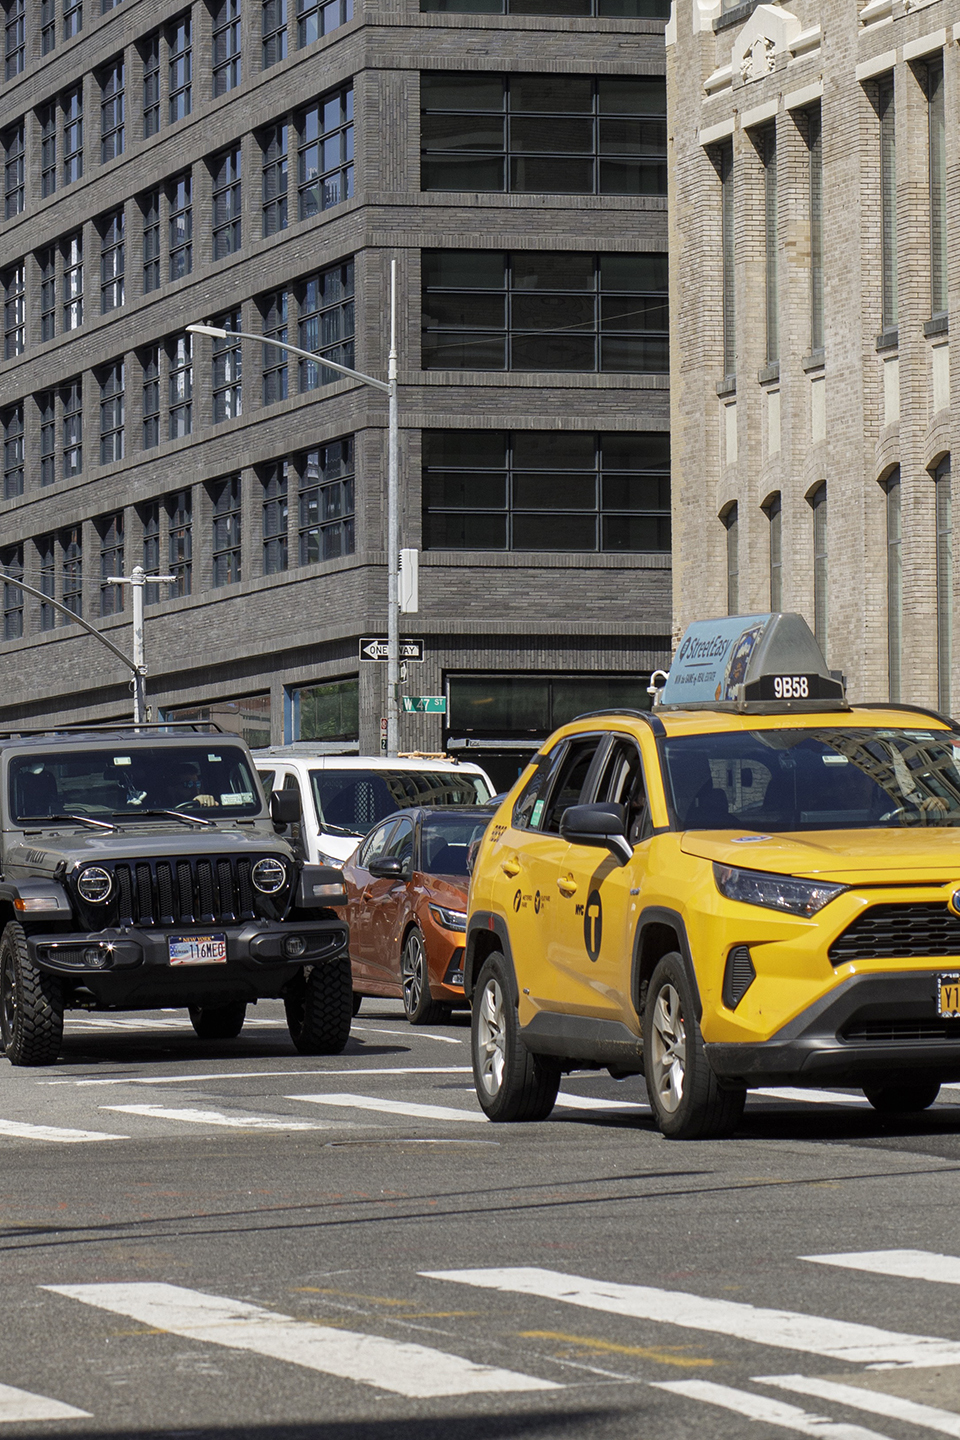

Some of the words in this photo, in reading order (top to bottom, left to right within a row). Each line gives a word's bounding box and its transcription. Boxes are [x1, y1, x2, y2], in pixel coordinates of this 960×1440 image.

[369, 646, 388, 655] ONE
[685, 636, 733, 662] StreetEasy
[774, 677, 809, 698] 9B58
[404, 698, 413, 710] W
[416, 698, 430, 710] 47
[434, 698, 444, 706] ST
[575, 904, 584, 916] NYC
[945, 987, 959, 1009] Y1
